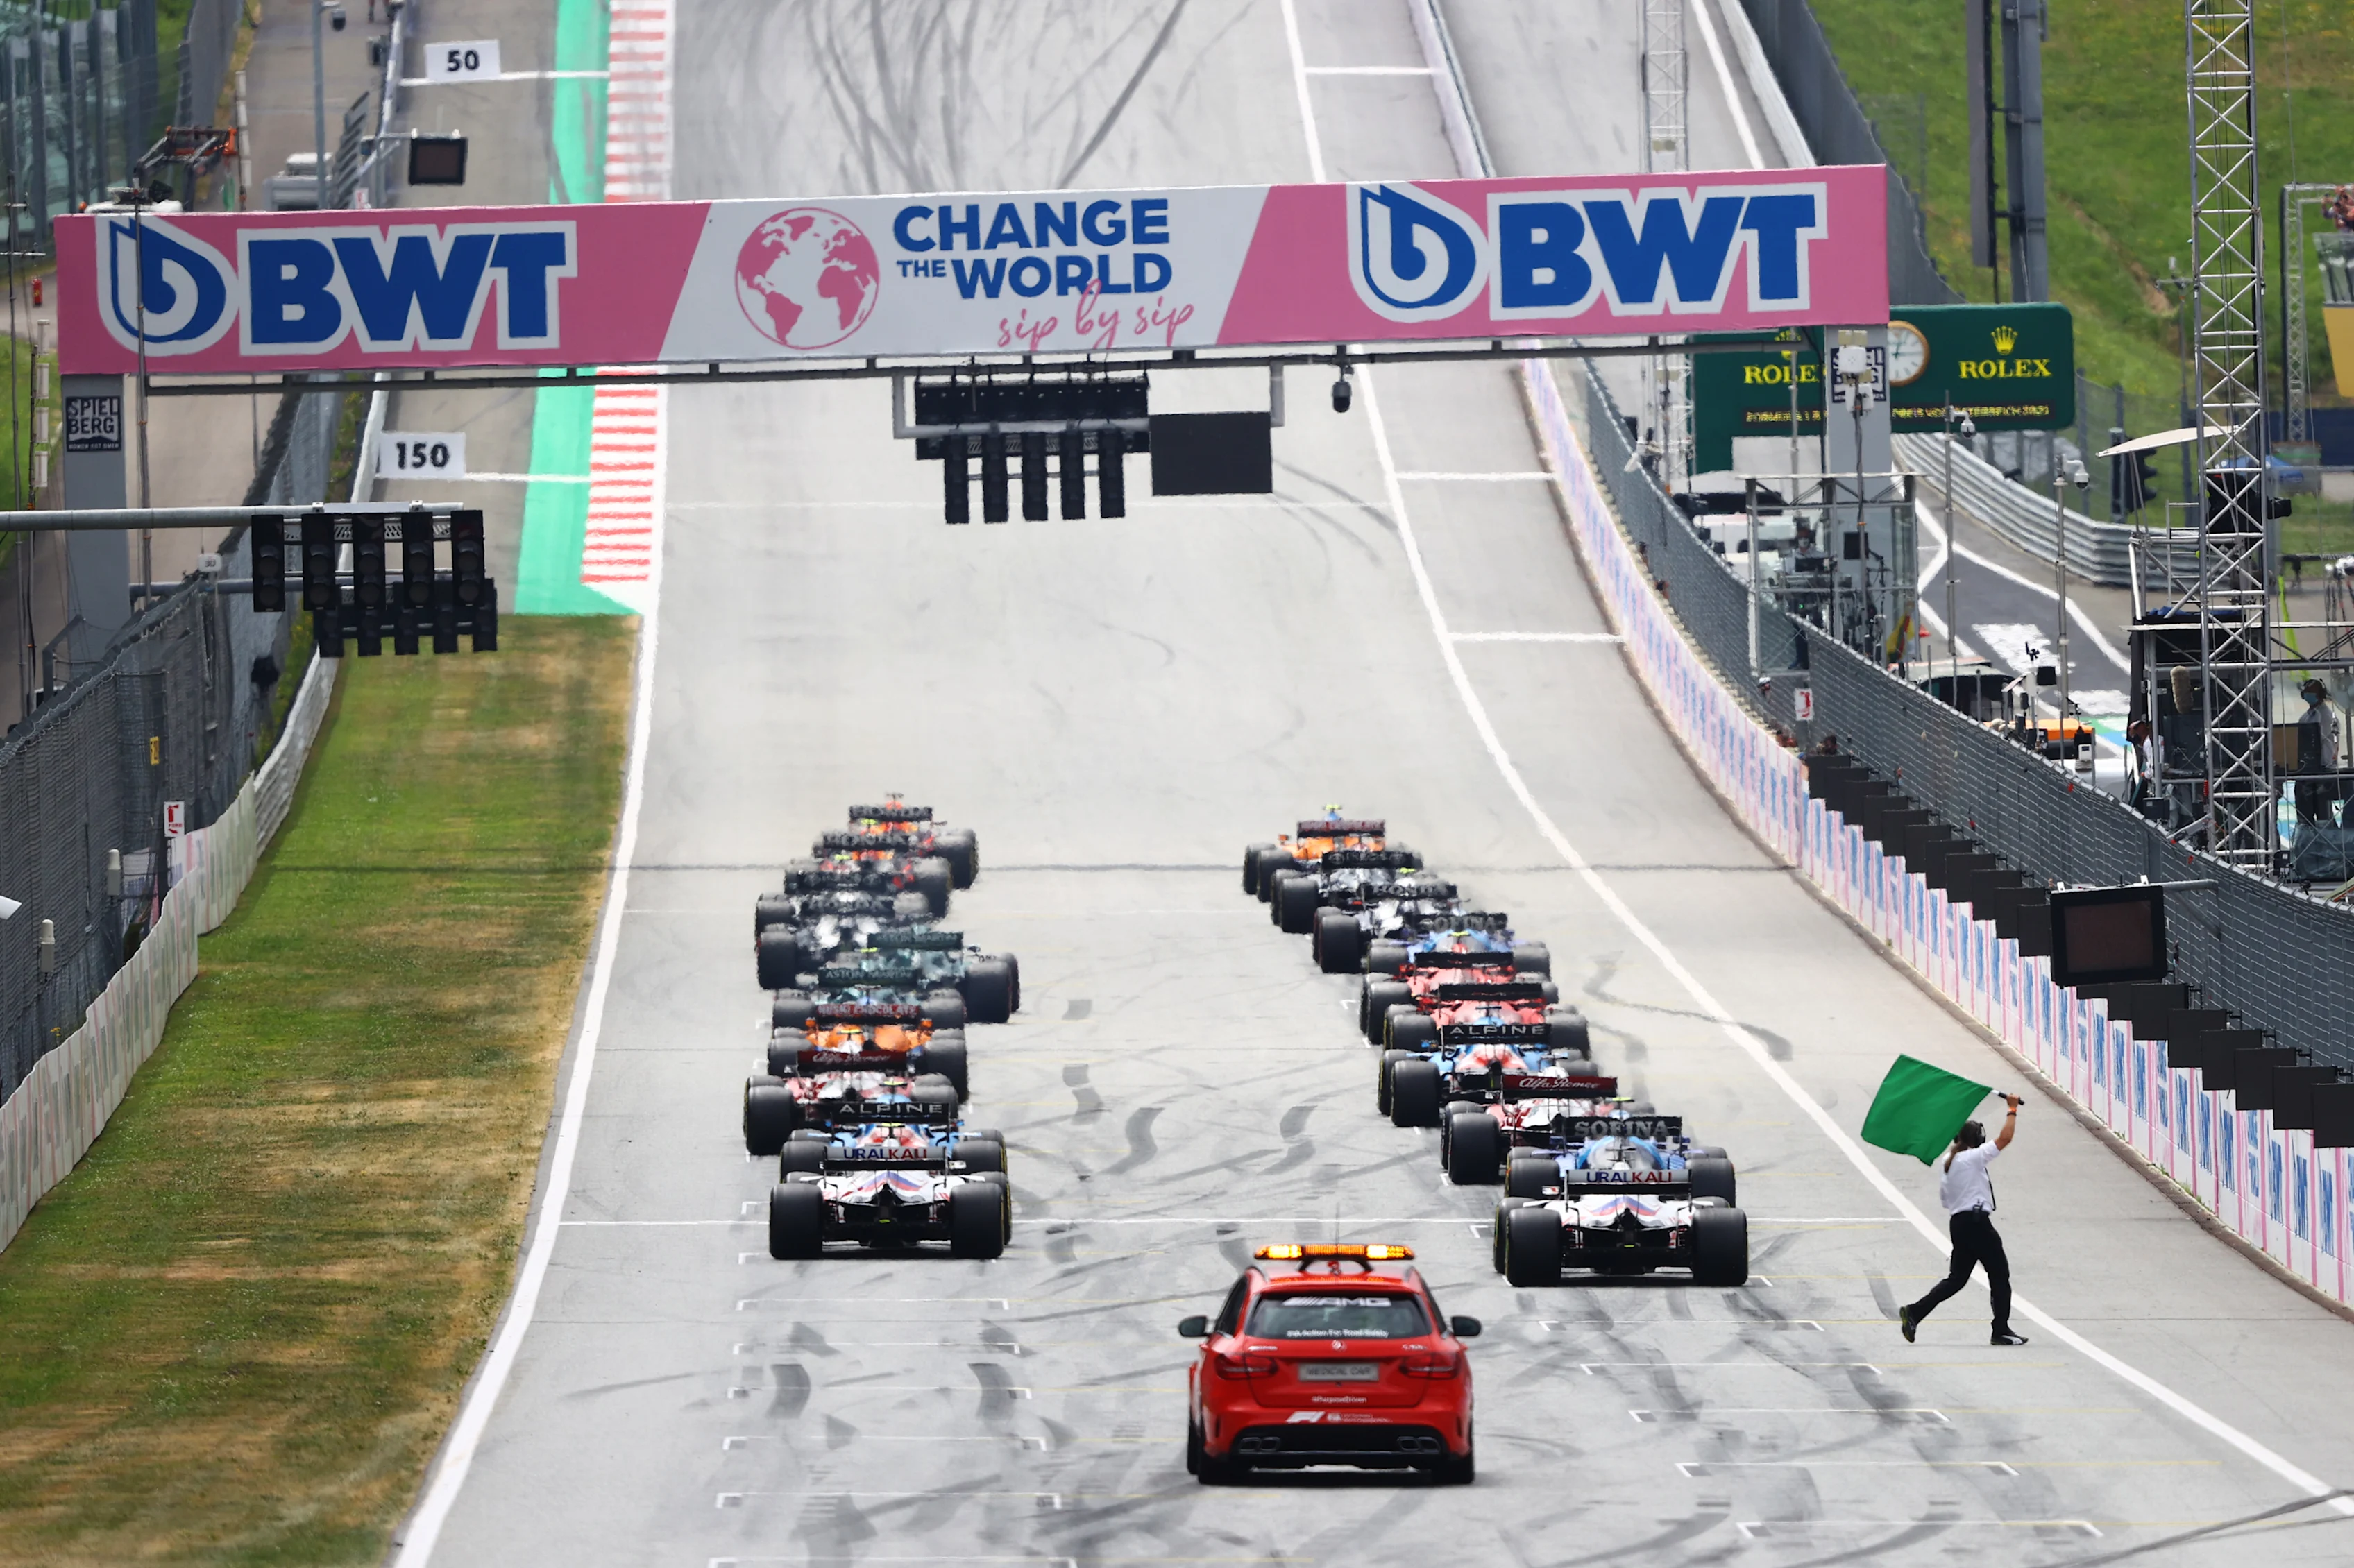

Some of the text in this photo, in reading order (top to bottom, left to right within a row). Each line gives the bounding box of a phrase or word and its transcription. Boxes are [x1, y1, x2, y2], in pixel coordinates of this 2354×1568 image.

[446, 49, 480, 72] 50
[893, 198, 1169, 252] CHANGE
[1498, 194, 1816, 308] BWT
[896, 253, 1172, 299] THE WORLD
[248, 232, 566, 344] BWT
[997, 278, 1194, 352] sip by sip
[1743, 364, 1827, 384] ROLE
[1958, 359, 2052, 378] ROLEX
[68, 398, 118, 416] SPIEL
[68, 417, 115, 434] BERG
[395, 441, 450, 470] 150
[825, 970, 863, 979] ASTON
[1449, 1025, 1545, 1035] ALPINE
[1518, 1077, 1600, 1089] Alfa Romeo
[839, 1104, 942, 1114] ALPINE
[1574, 1120, 1669, 1137] SOFINA
[843, 1148, 927, 1159] URALKALI
[1586, 1171, 1672, 1183] URALKALI
[1320, 1297, 1391, 1307] AMG
[1306, 1366, 1372, 1376] MEDICAL CAR
